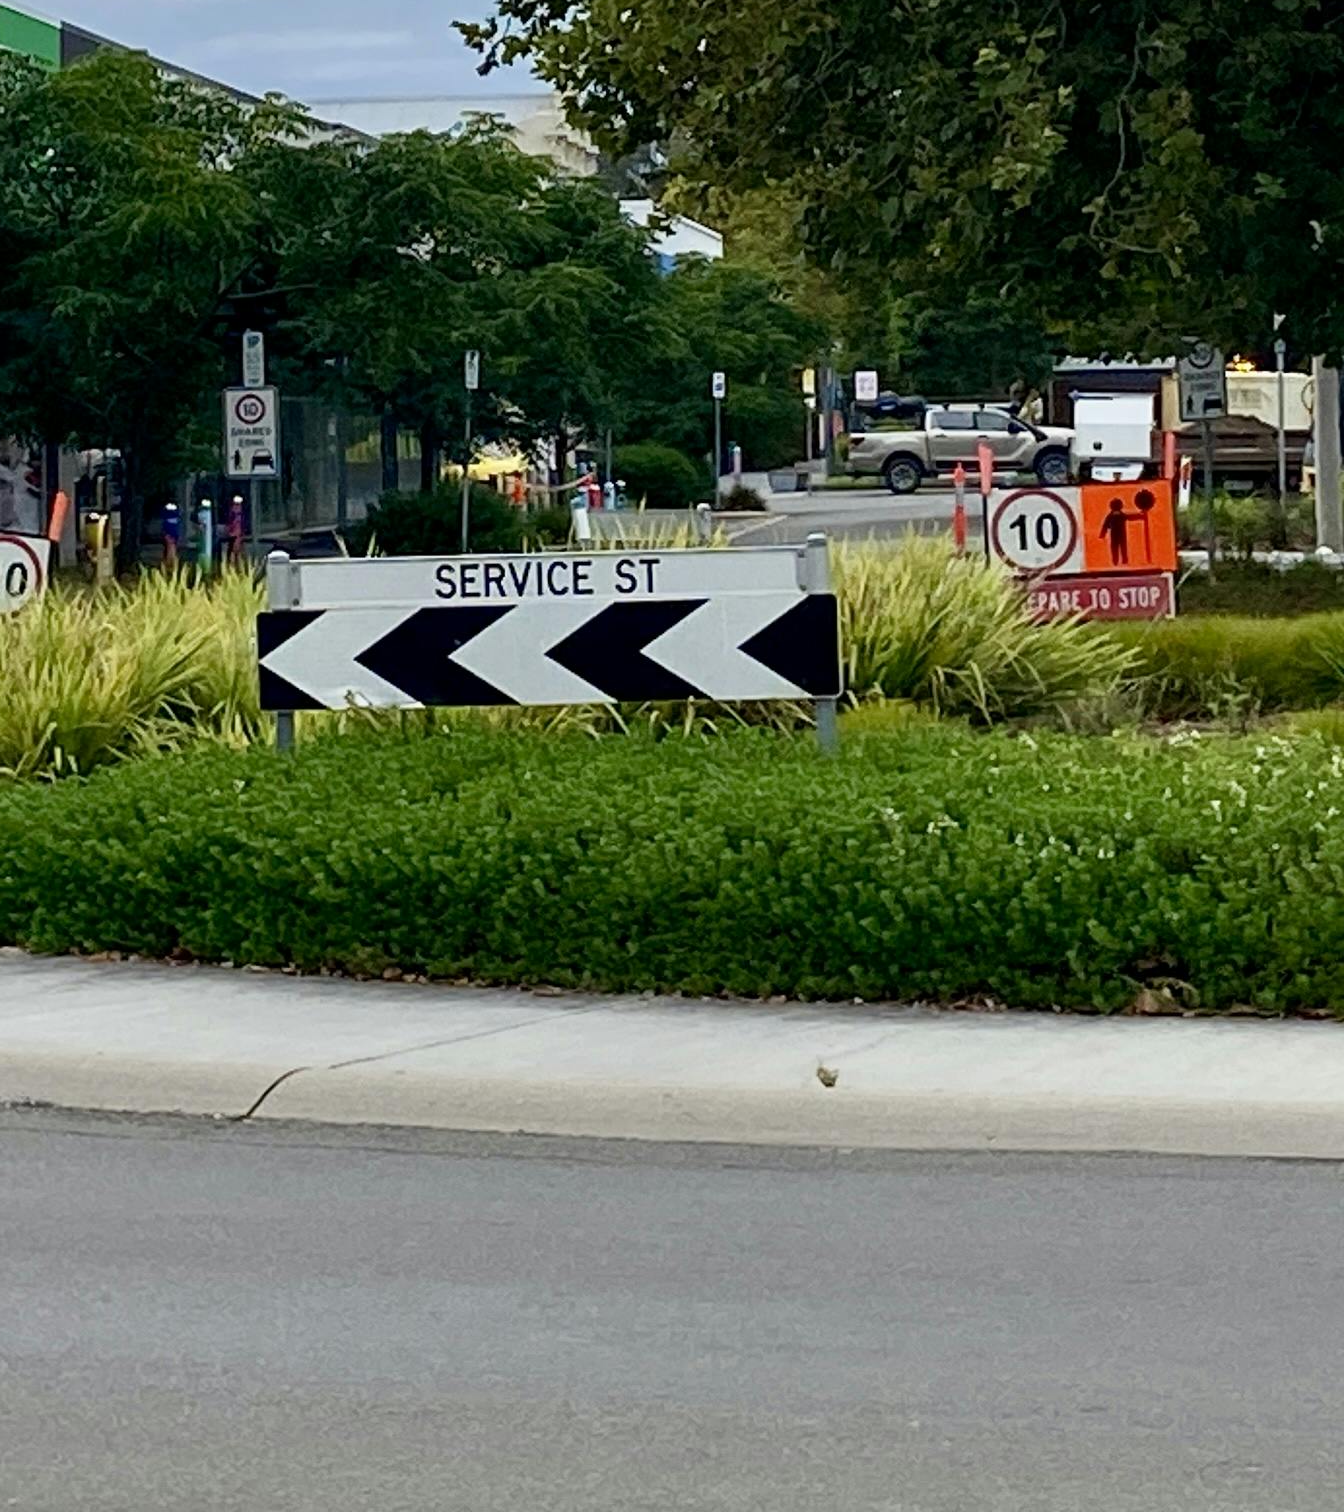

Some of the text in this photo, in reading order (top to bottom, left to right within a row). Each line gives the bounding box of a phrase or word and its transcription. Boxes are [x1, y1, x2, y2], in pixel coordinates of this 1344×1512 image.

[243, 402, 259, 417] 10
[1009, 512, 1060, 551] 10
[435, 558, 661, 599] SERVICE ST
[1089, 587, 1111, 610] TO
[1118, 586, 1161, 609] STOP
